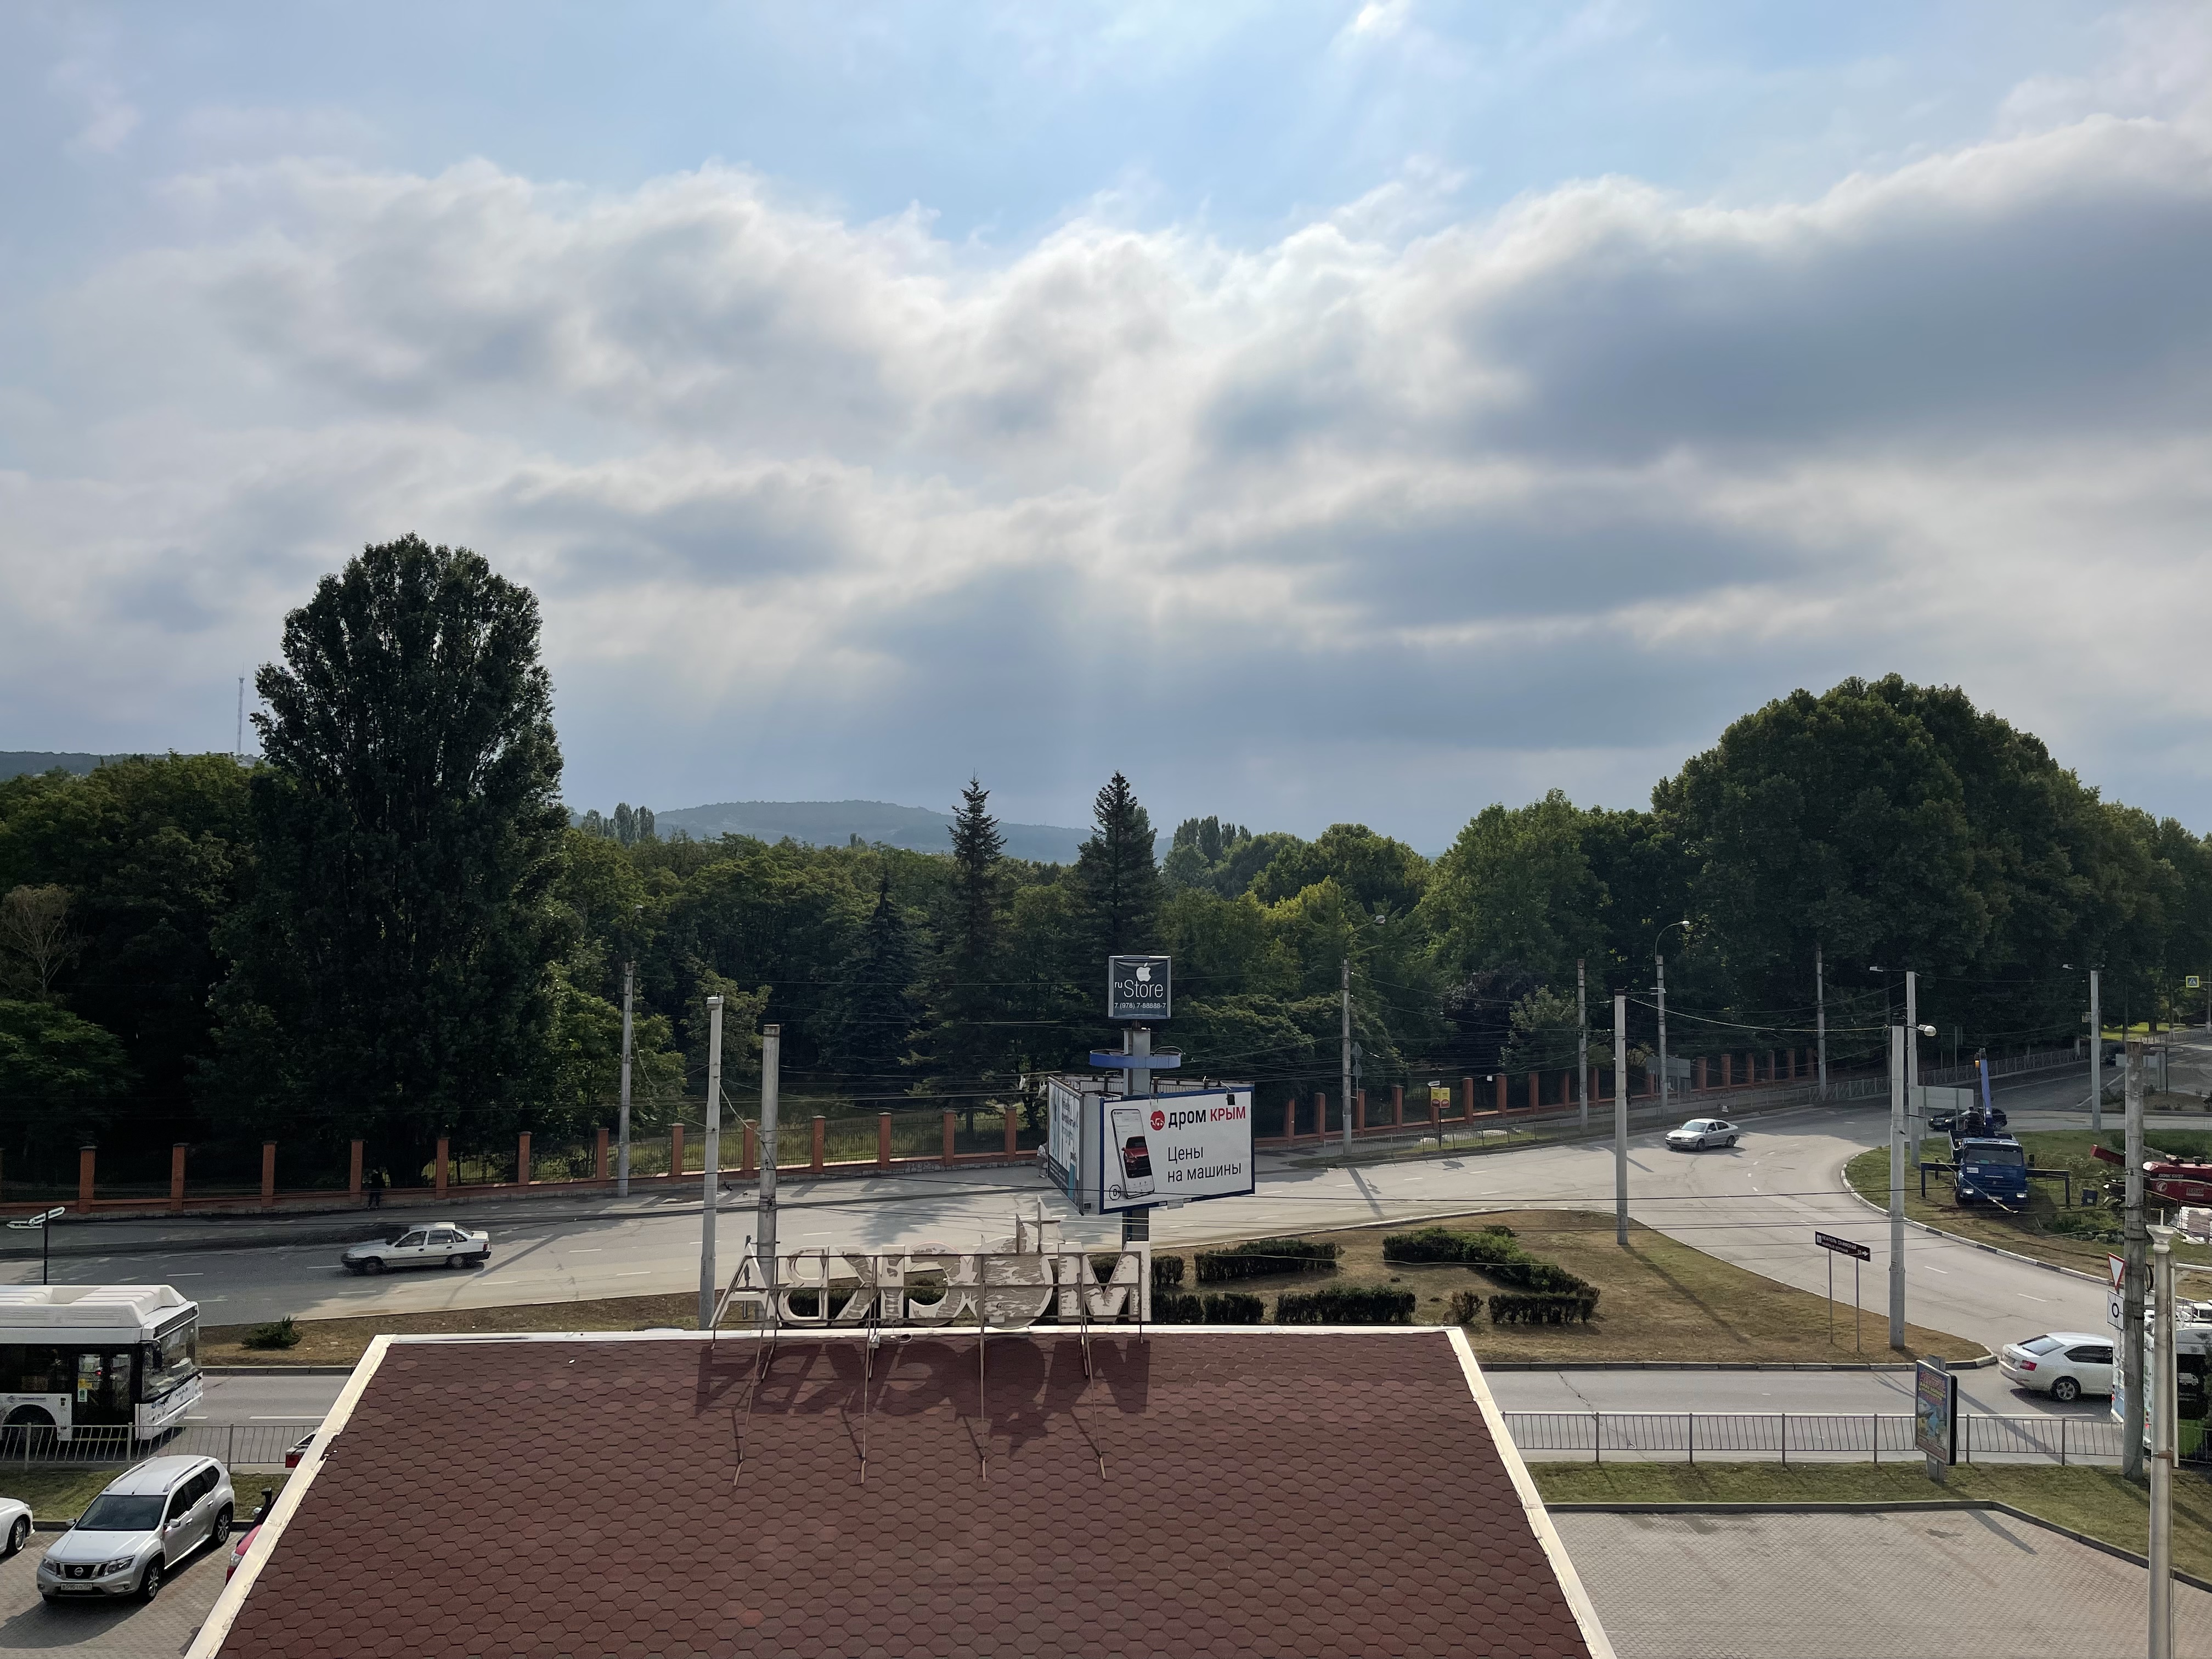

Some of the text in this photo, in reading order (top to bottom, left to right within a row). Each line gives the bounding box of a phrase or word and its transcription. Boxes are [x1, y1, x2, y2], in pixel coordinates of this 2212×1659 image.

[1124, 979, 1163, 998] Store
[1168, 1106, 1246, 1130] дром КРЫМ
[1168, 1146, 1203, 1164] Цены
[1167, 1163, 1241, 1183] на машины
